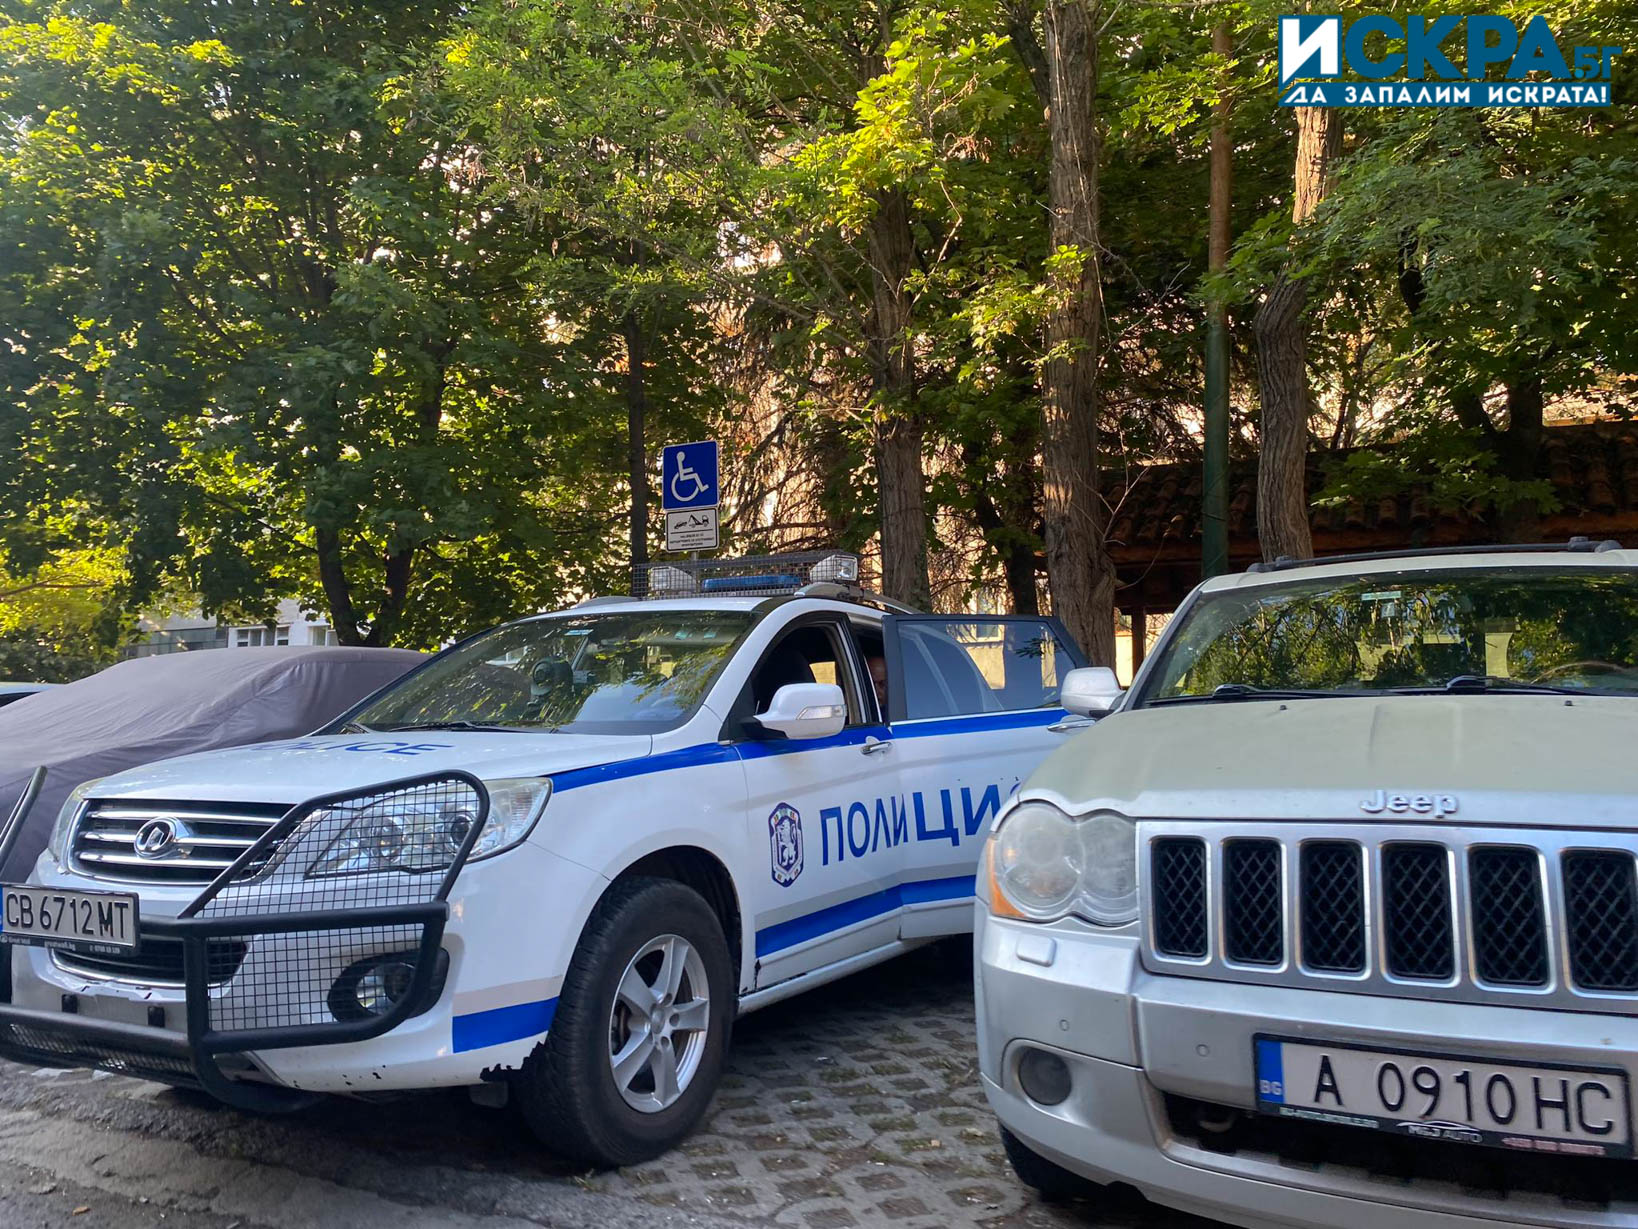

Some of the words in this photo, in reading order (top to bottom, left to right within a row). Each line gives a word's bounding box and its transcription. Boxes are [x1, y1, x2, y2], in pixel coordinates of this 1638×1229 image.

[819, 783, 1021, 866] ПОЛИЦИ
[1361, 789, 1458, 819] Jeep
[1259, 1079, 1282, 1096] BG
[1314, 1054, 1344, 1106] A
